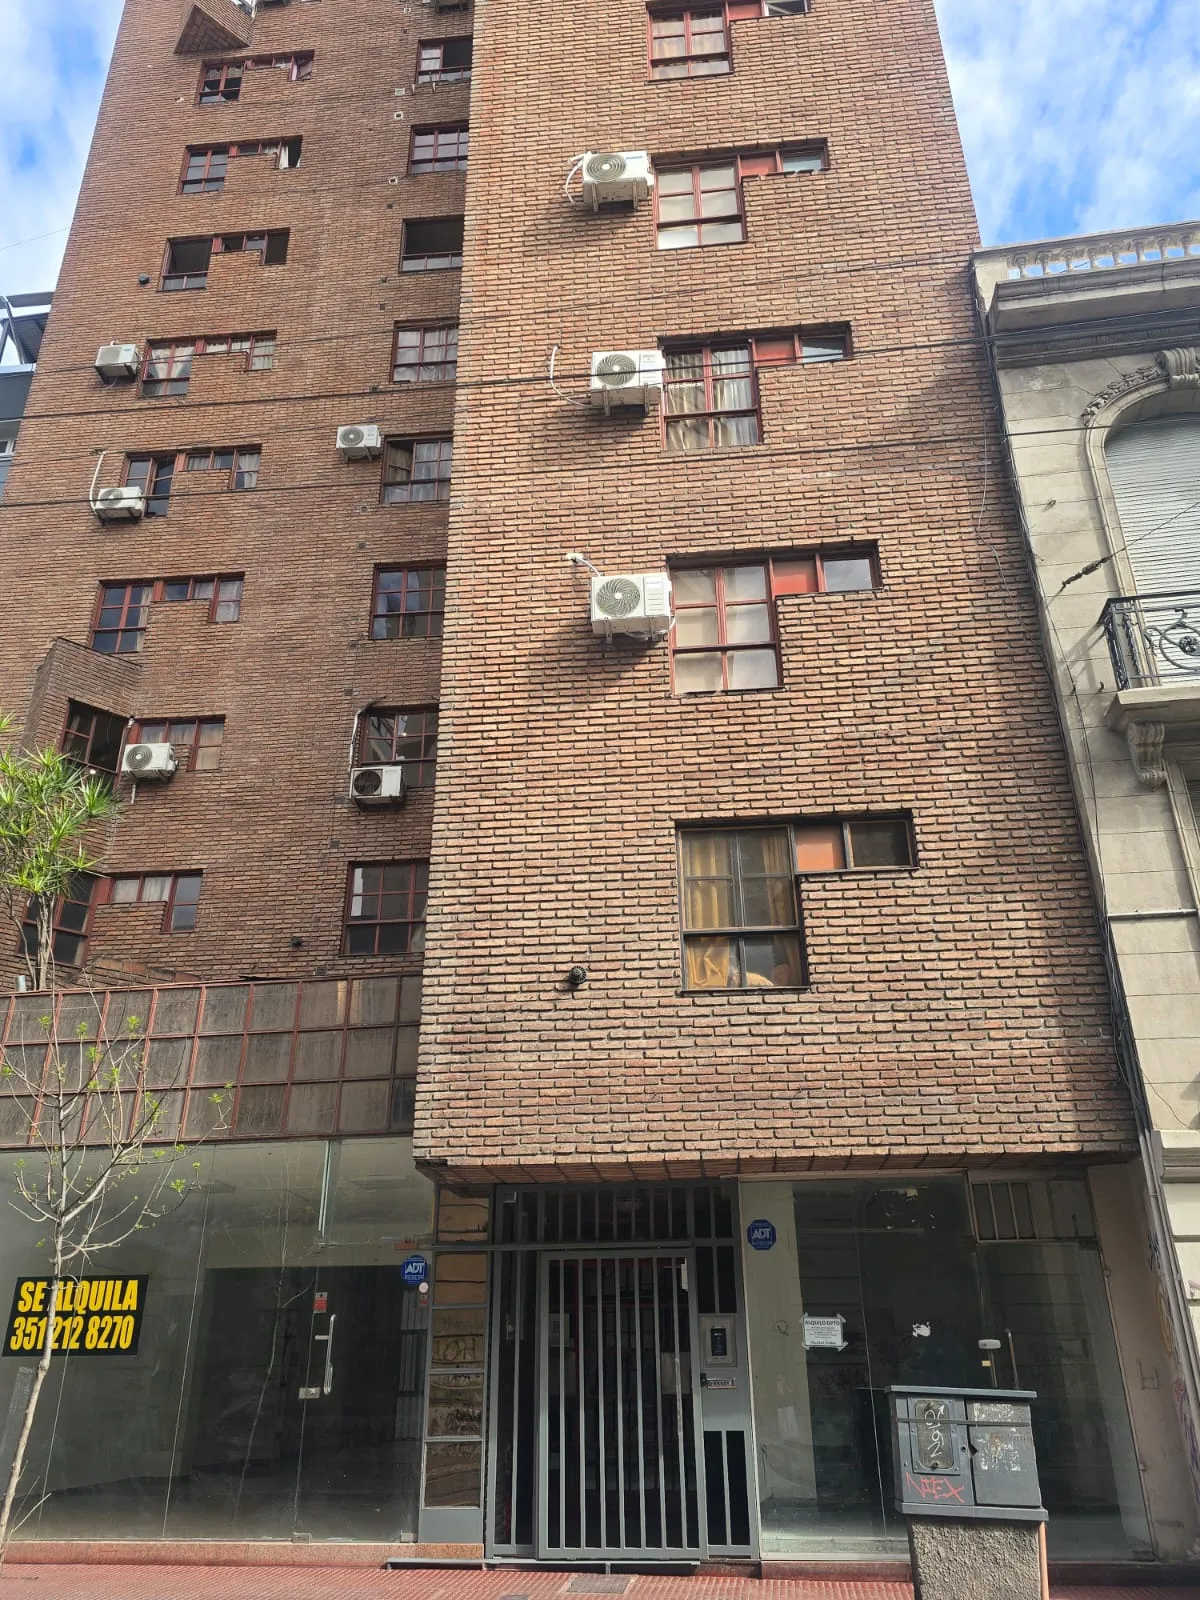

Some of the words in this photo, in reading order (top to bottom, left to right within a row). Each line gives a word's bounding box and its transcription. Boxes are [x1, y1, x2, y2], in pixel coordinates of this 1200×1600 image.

[752, 1228, 772, 1239] ADT
[405, 1262, 424, 1273] ADT
[17, 1281, 47, 1313] SE
[10, 1316, 49, 1350] 351
[51, 1316, 84, 1349] 212
[85, 1315, 135, 1349] 8270
